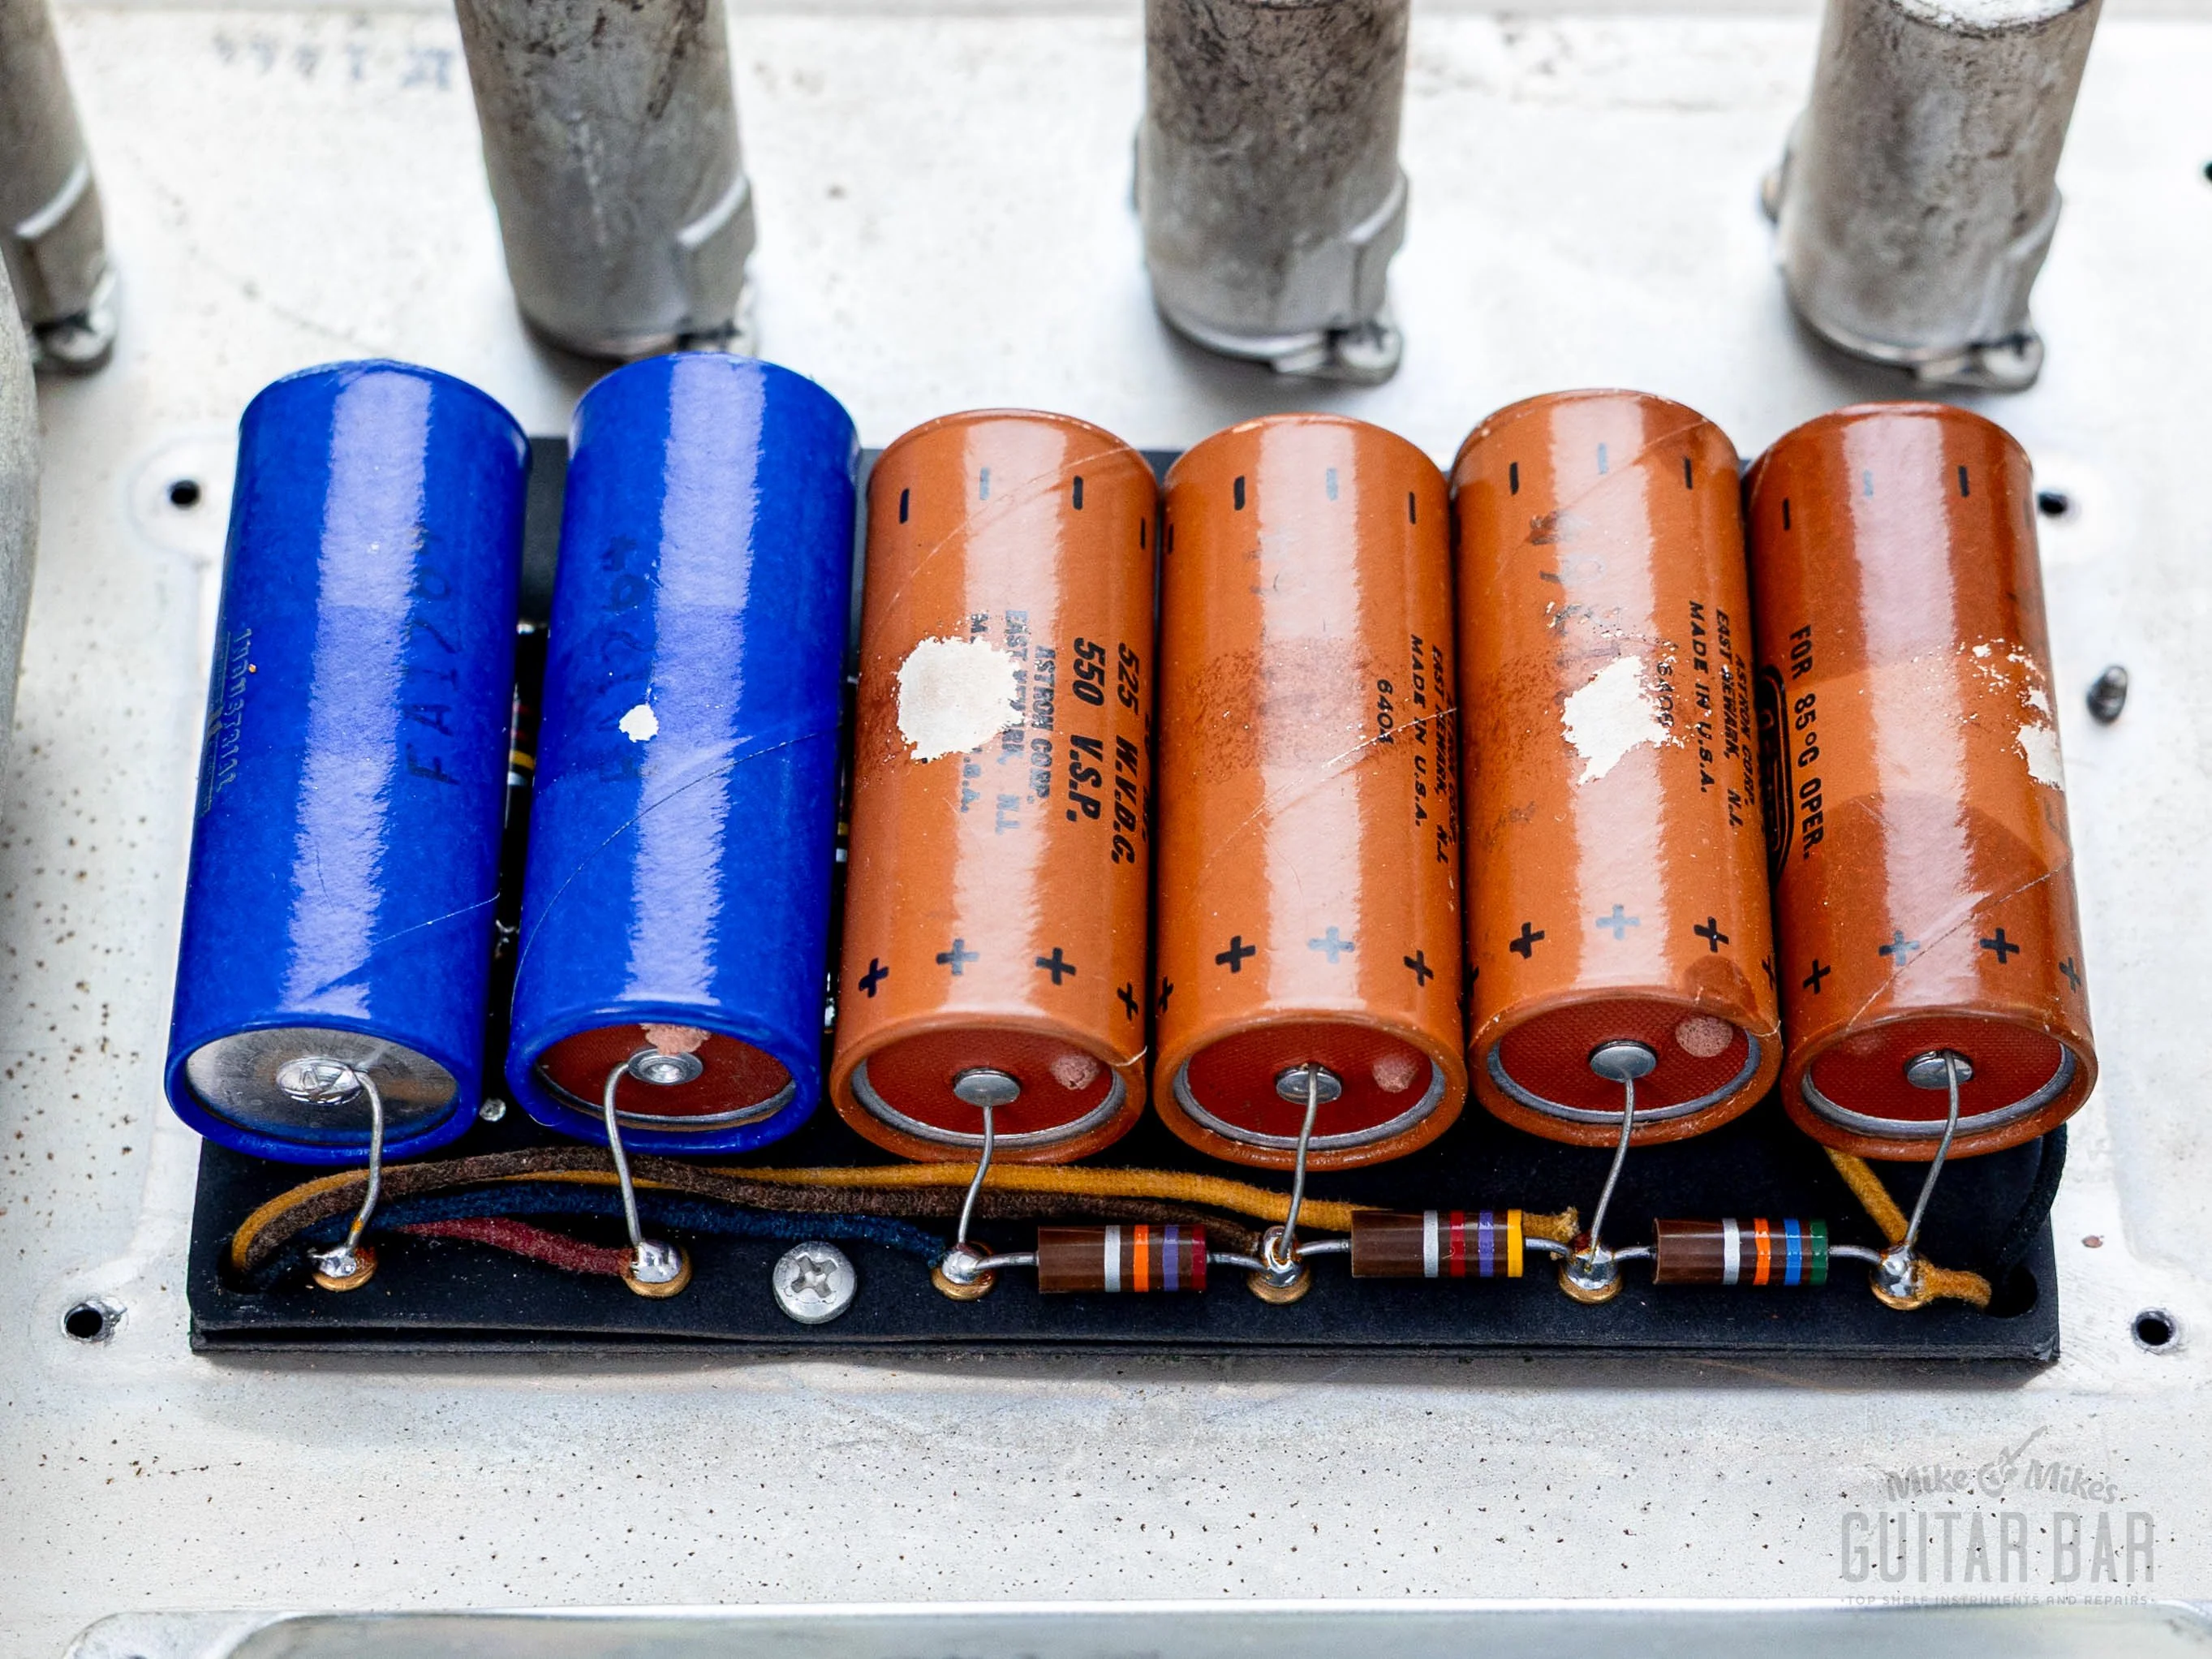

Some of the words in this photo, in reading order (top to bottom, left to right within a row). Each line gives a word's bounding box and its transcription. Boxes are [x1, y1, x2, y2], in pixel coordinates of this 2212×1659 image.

[1005, 609, 1029, 662] EAST
[1073, 637, 1106, 706] 550
[1410, 634, 1427, 709] MADE
[1689, 600, 1710, 674] MADE
[1789, 624, 1814, 680] FOR
[1031, 644, 1056, 731] ASTRON
[1117, 643, 1139, 715] 525
[1431, 644, 1445, 700] EAST
[1695, 683, 1711, 710] IN
[1735, 653, 1751, 741] ASTRON
[1376, 678, 1395, 745] 6404
[1413, 717, 1427, 746] IN
[1716, 608, 1733, 666] EAST
[1728, 788, 1744, 828] N.J.
[1026, 737, 1052, 804] CORP.
[1065, 735, 1104, 821] V.S.P.
[1433, 704, 1448, 796] NEWARK,
[1698, 721, 1715, 794] U.S.A.
[1741, 744, 1755, 806] CORP.
[994, 793, 1021, 835] N.J.
[1111, 735, 1138, 864] W.V.D.C.
[1414, 755, 1428, 827] U.S.A.
[1800, 777, 1826, 860] OPER.
[1436, 824, 1449, 864] N.J.
